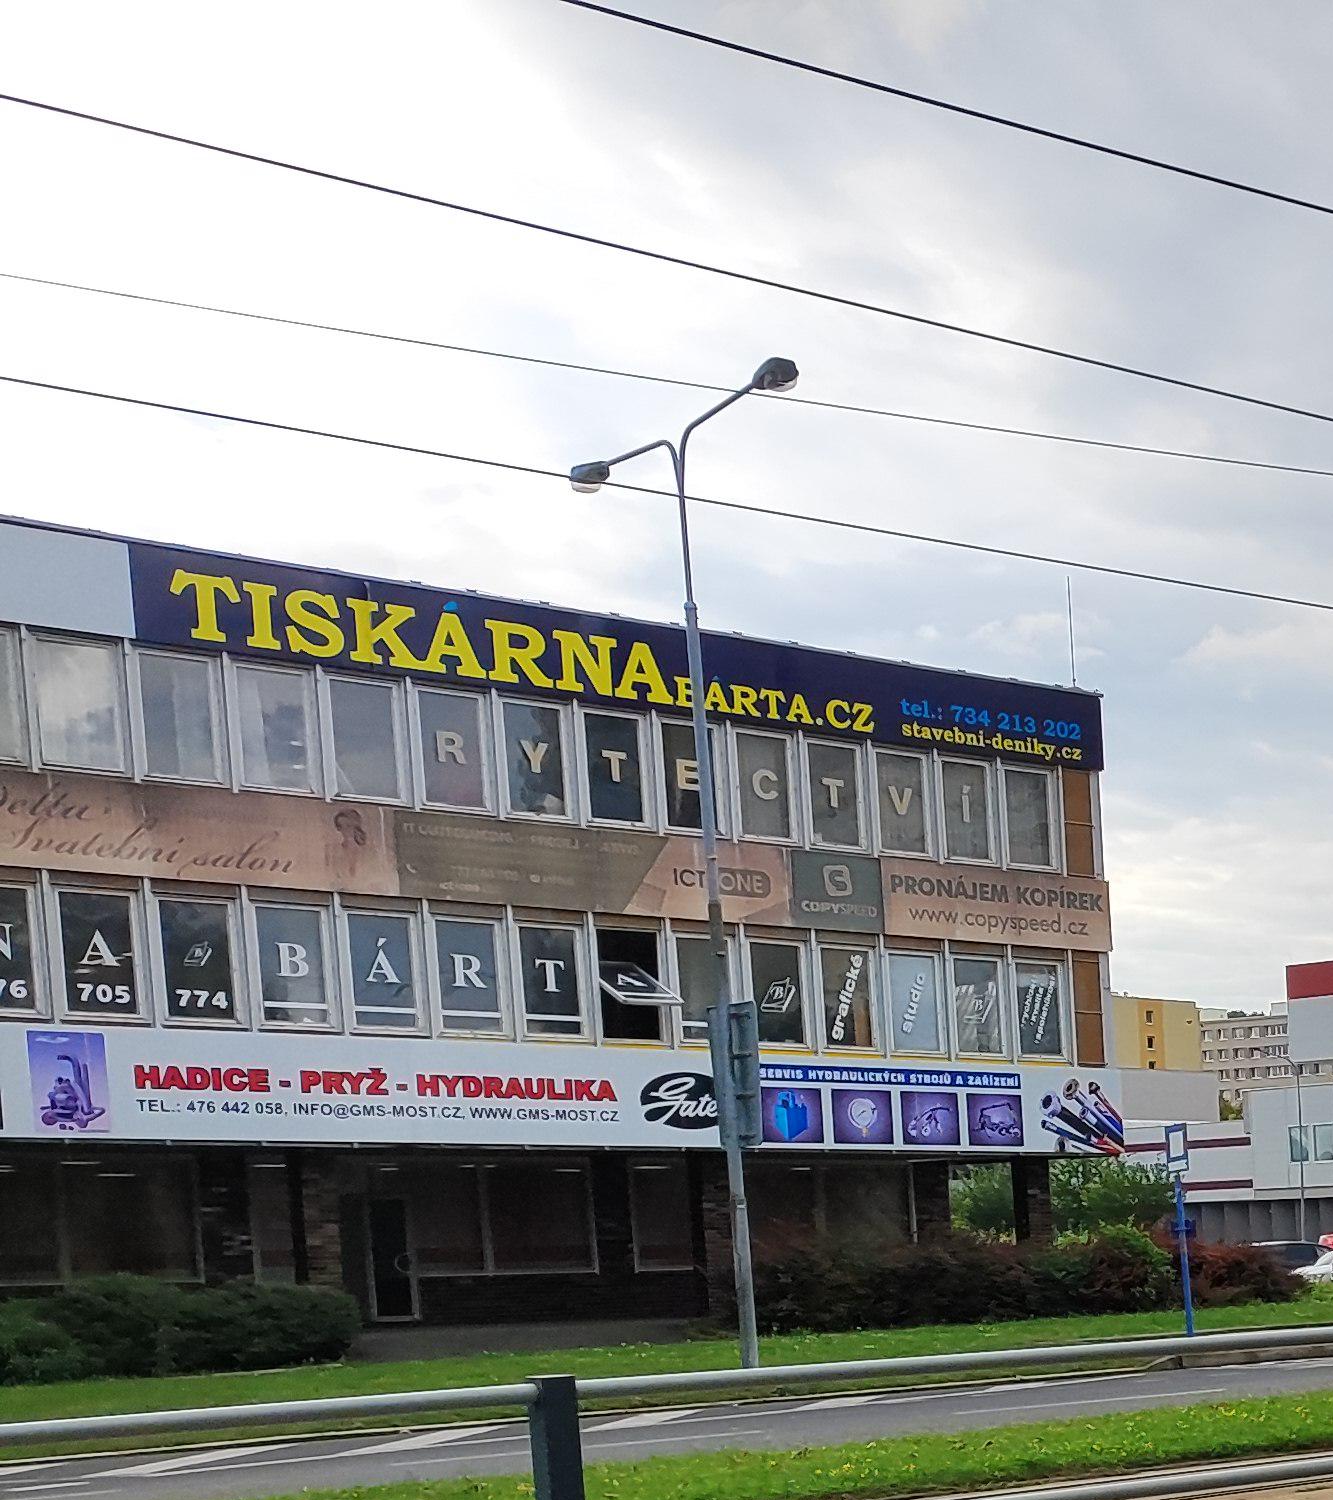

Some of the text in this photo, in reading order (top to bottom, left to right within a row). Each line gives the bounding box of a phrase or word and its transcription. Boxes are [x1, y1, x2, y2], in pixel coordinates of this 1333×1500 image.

[900, 698, 1081, 741] tel.: 734 213 202
[673, 868, 764, 893] ICT ONE
[890, 872, 1104, 912] PRONÁJEM KOPÍREK
[908, 906, 1089, 936] www.copyspeed.cz
[77, 983, 131, 1004] 705
[175, 988, 229, 1009] 774
[902, 972, 926, 1035] studio
[133, 1064, 271, 1093] HADICE
[300, 1067, 389, 1096] PRYŽ
[416, 1073, 618, 1102] HYDRAULIKA
[136, 1099, 181, 1113] TEL.:
[186, 1100, 216, 1114] 476
[221, 1101, 250, 1115] 442
[469, 1106, 620, 1122] WWW.GMS-MOST.CZ
